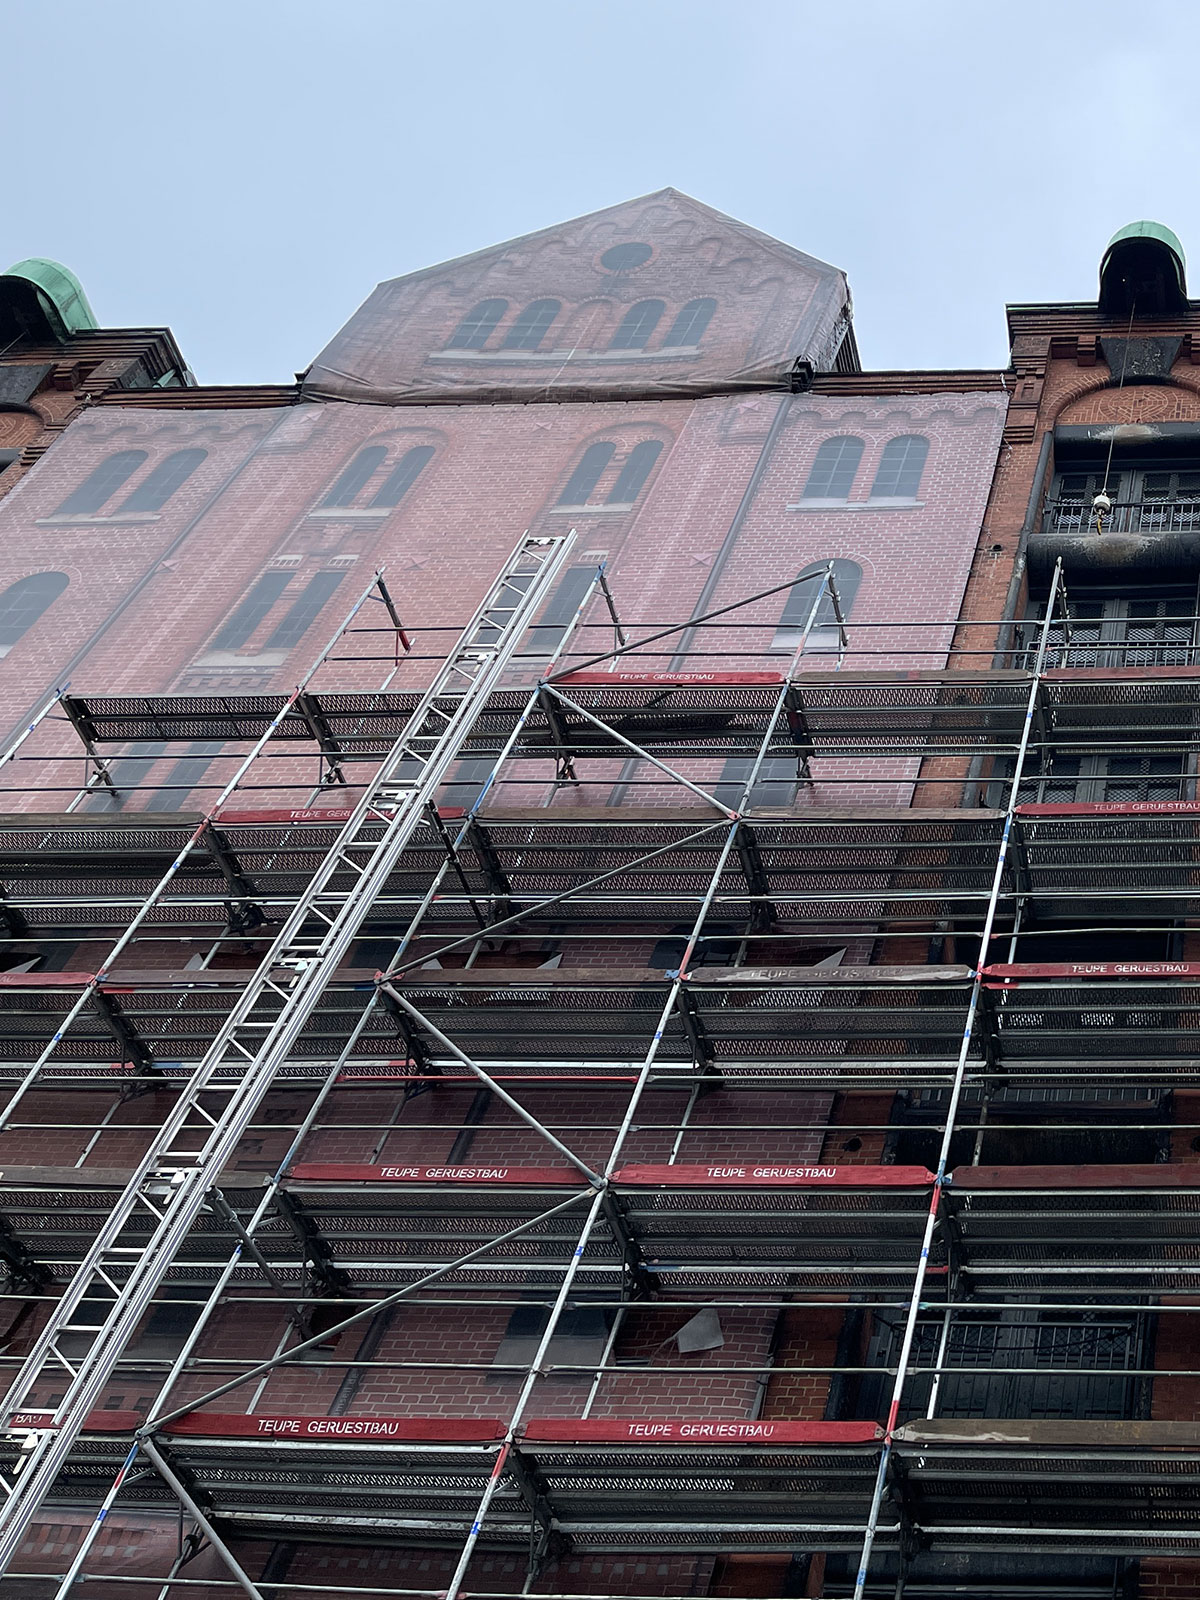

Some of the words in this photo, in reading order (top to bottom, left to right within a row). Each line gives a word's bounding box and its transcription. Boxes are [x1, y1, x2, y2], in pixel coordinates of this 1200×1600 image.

[619, 673, 649, 681] TEUPE
[653, 673, 715, 681] GERUESTBAU
[1132, 803, 1200, 811] GERUESTBAU
[290, 810, 322, 819] TEUPE
[1072, 965, 1108, 973] TEUPE
[1114, 964, 1189, 973] GERUESTBAU
[380, 1167, 420, 1177] TEUPE
[425, 1167, 508, 1179] GERUESTBAU
[707, 1167, 746, 1178] TEUPE
[752, 1167, 837, 1178] GERUESTBAU
[257, 1419, 301, 1432] TEUPE
[307, 1420, 399, 1435] GERUESTBAU
[627, 1424, 673, 1436] TEUPE
[680, 1424, 775, 1437] GERUESTBAU
